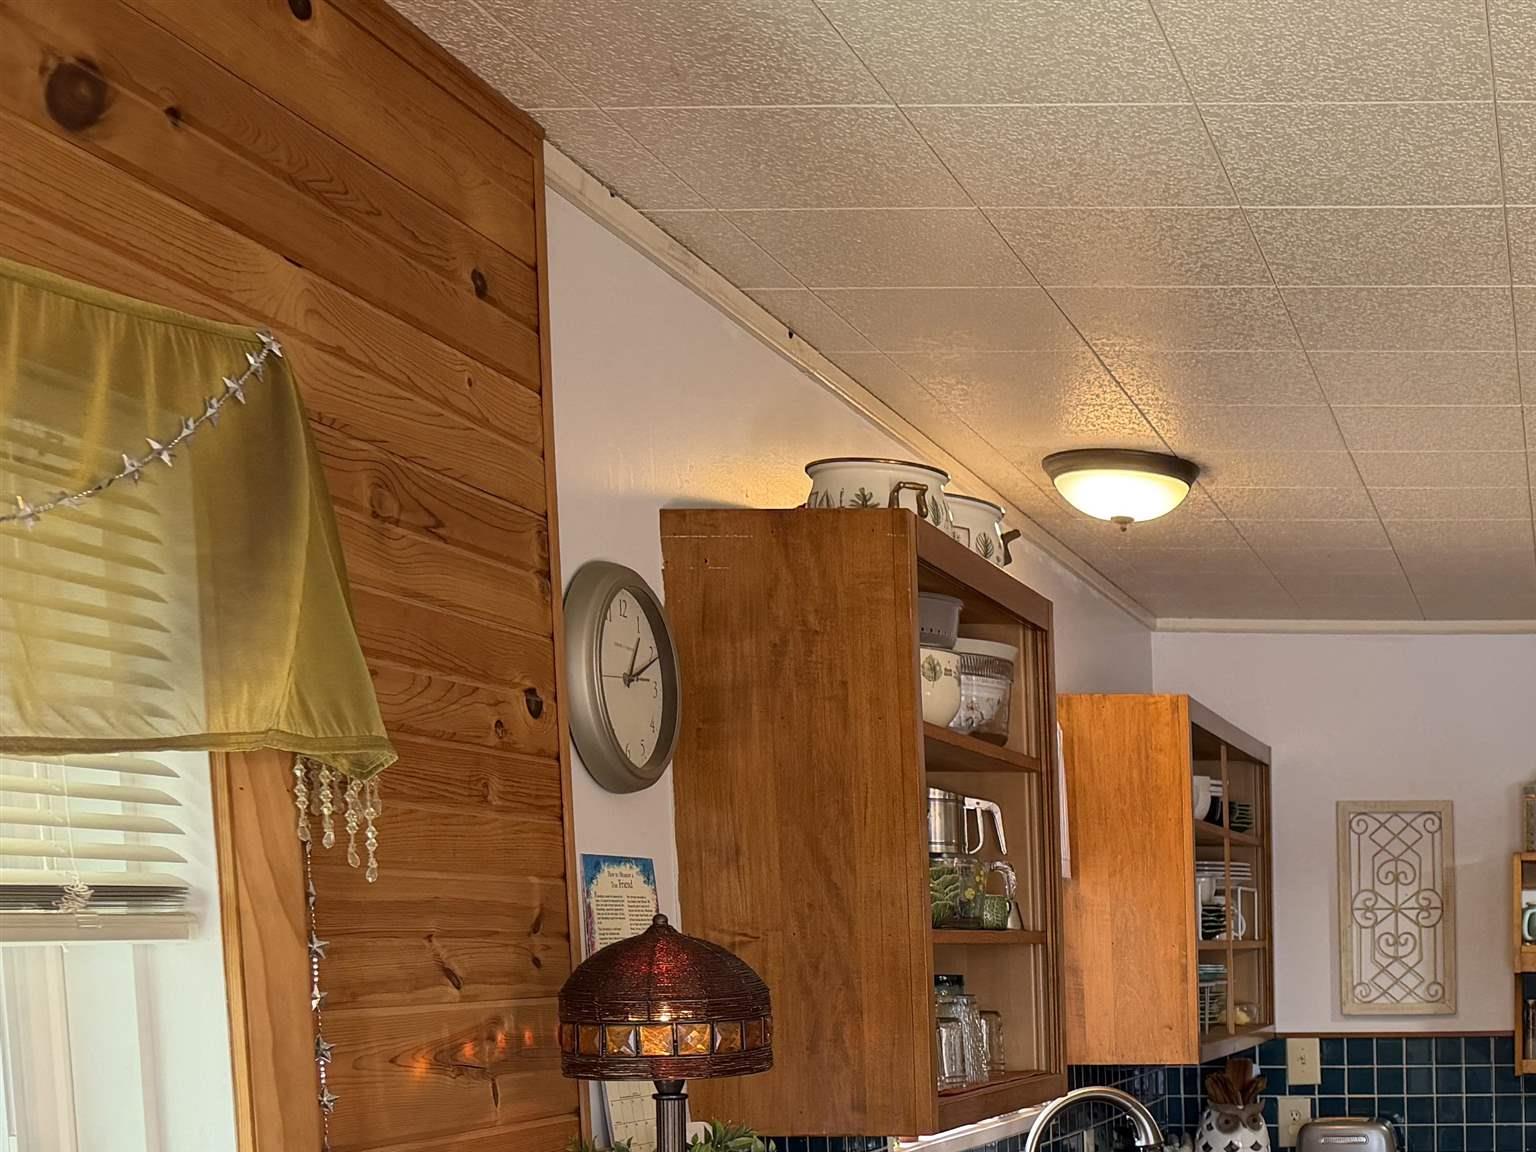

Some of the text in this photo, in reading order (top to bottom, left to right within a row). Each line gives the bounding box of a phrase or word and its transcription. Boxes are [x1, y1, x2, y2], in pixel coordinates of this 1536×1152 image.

[619, 599, 628, 618] 12
[636, 616, 641, 634] 1
[652, 681, 658, 699] 3
[649, 716, 655, 733] 4
[640, 739, 646, 757] 5
